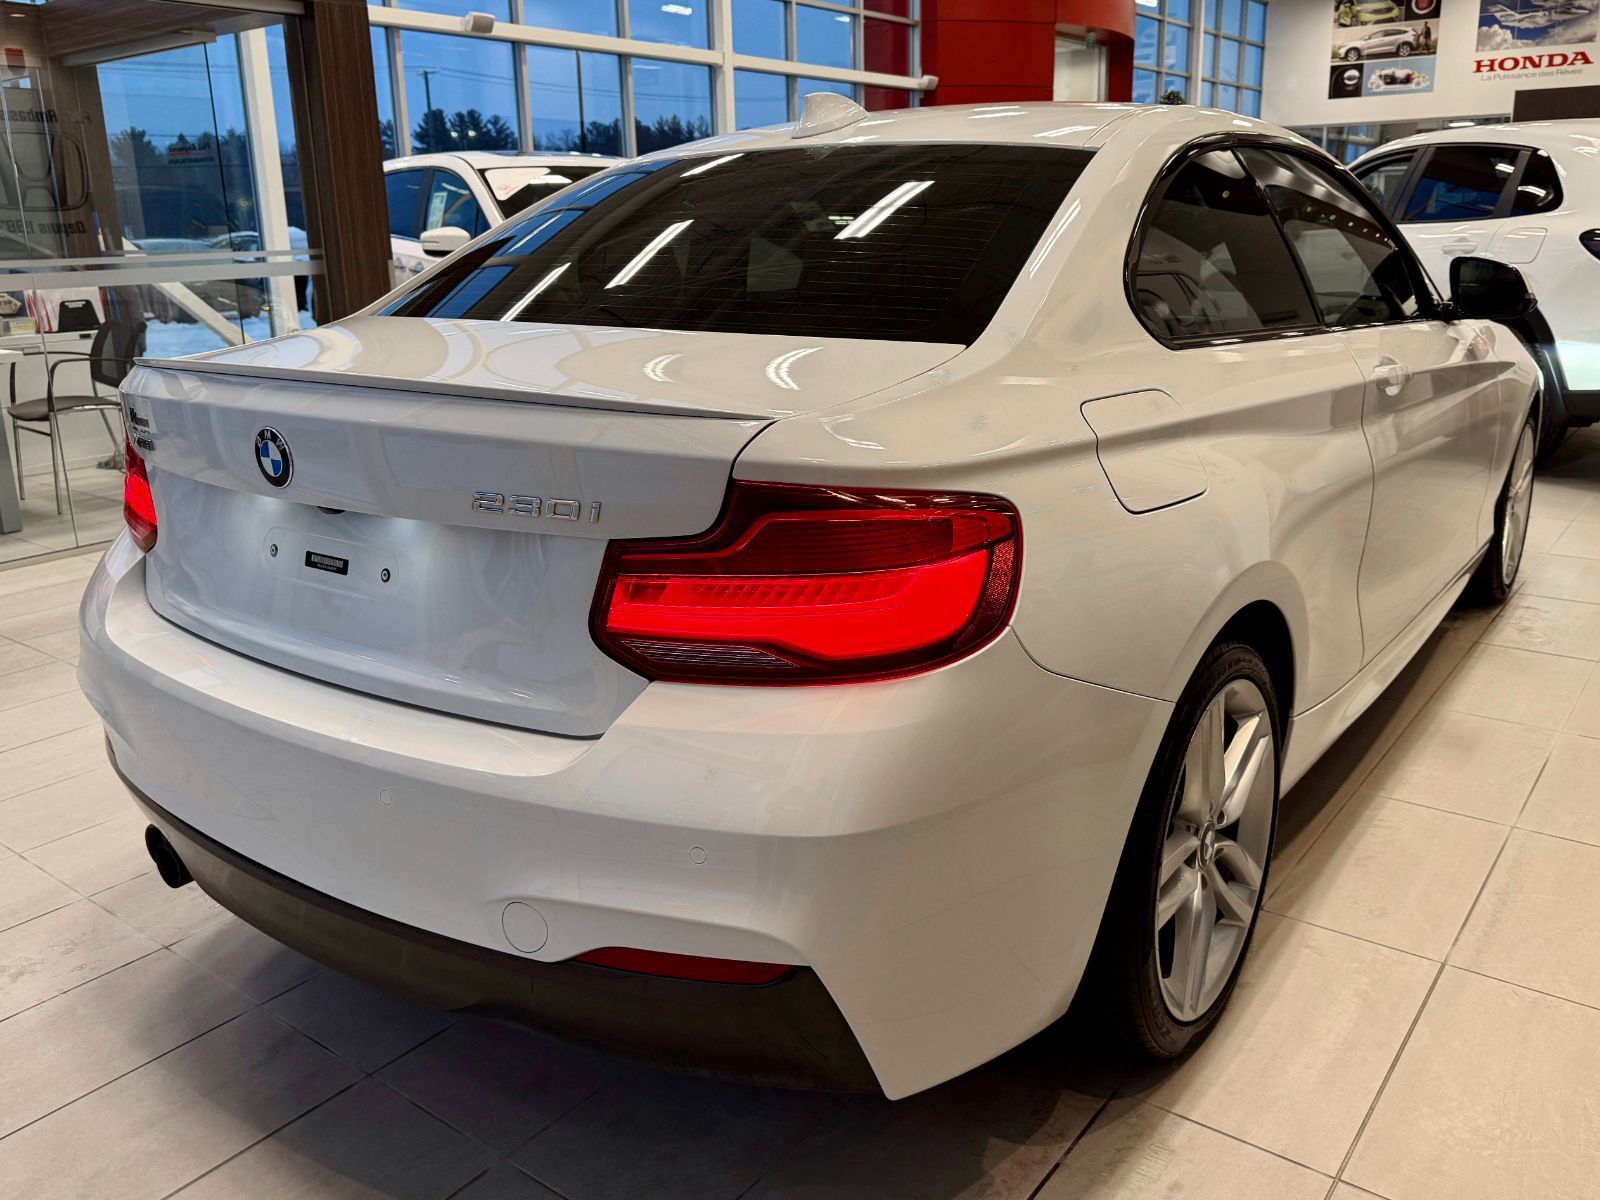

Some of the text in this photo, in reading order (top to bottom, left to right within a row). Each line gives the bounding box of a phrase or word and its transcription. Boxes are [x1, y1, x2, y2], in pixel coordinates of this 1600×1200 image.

[1473, 51, 1594, 73] HONDA
[1493, 71, 1537, 81] Puissance
[1538, 69, 1555, 78] des
[257, 430, 285, 451] BMW
[472, 491, 602, 523] 230i
